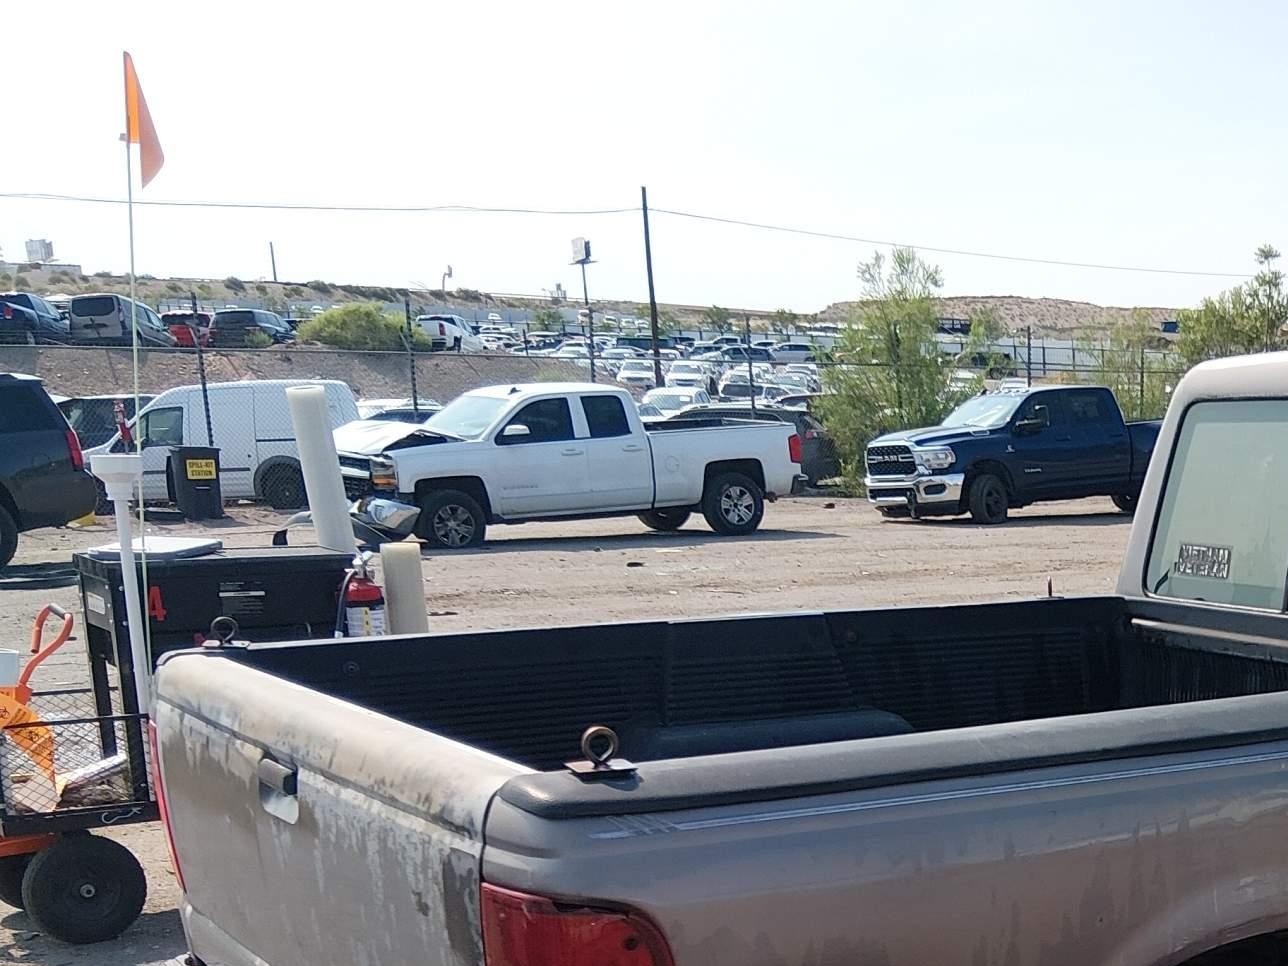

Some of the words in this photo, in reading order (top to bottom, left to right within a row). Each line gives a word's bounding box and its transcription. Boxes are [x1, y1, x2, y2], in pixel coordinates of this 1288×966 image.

[1181, 544, 1229, 563] VIETNAM
[1179, 558, 1228, 578] VETERAN
[149, 586, 167, 621] 4
